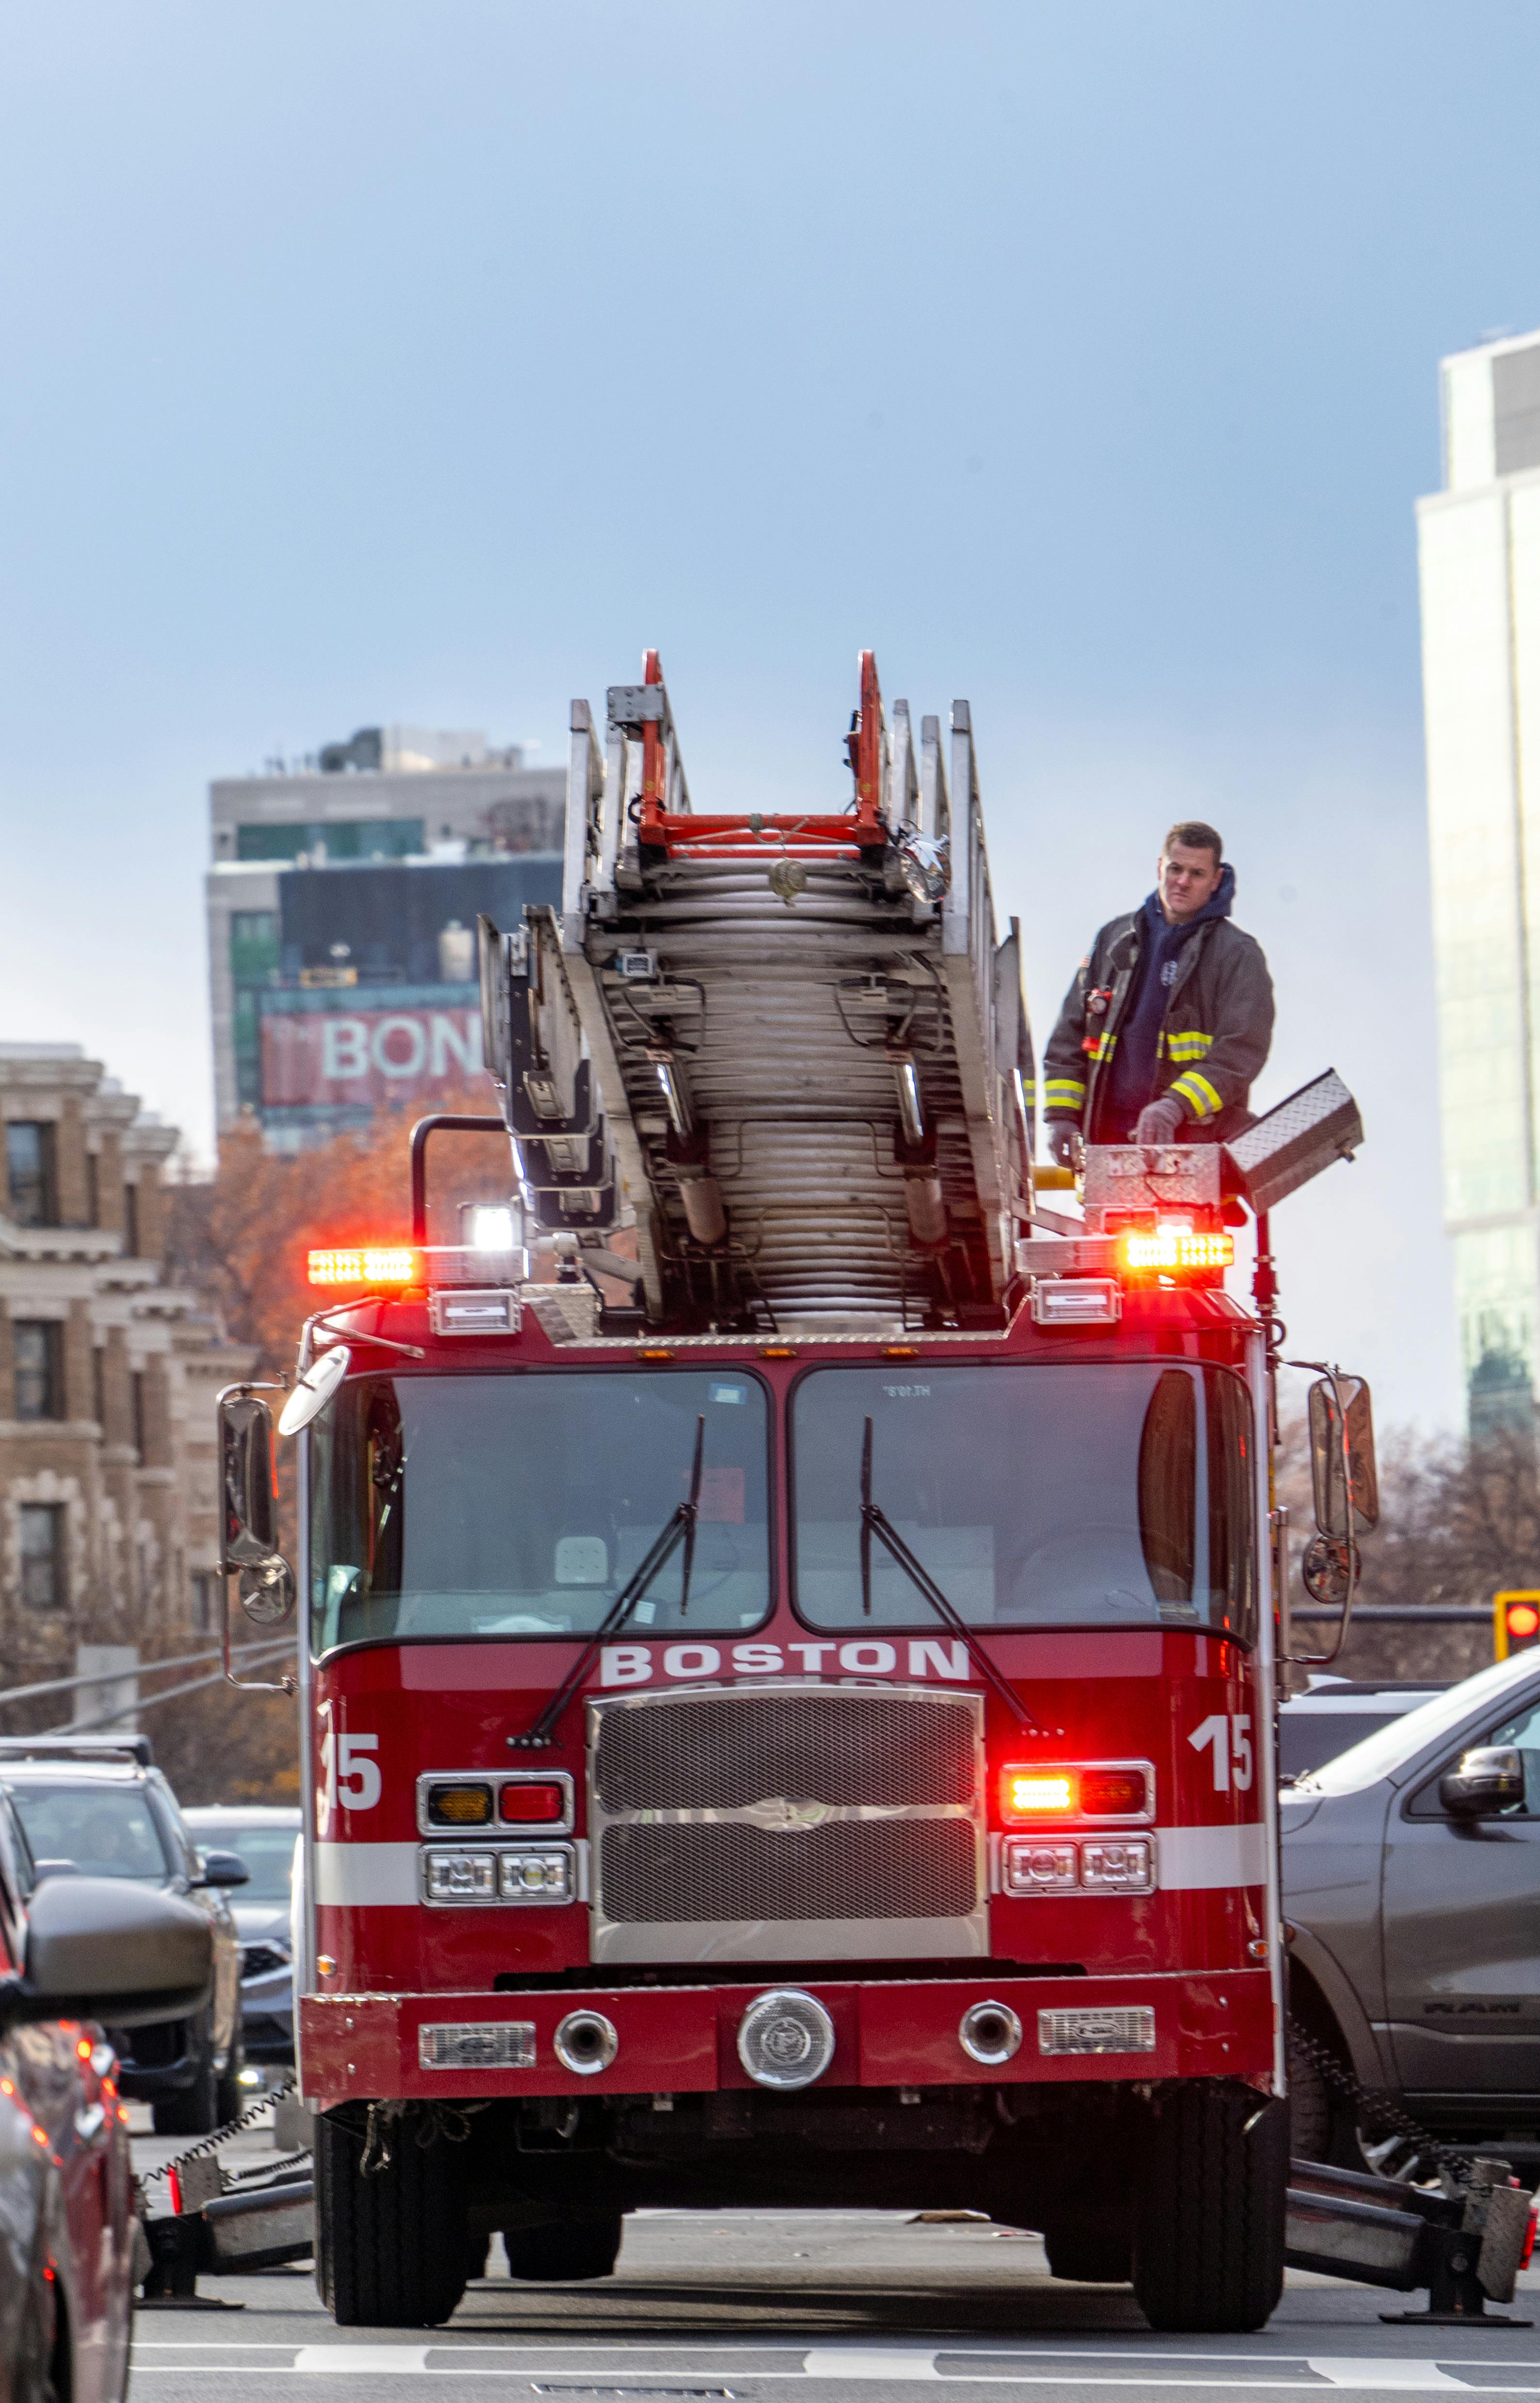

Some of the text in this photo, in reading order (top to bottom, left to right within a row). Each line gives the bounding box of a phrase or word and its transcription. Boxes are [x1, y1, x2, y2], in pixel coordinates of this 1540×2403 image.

[601, 1640, 970, 1687] BOSTON
[320, 1733, 382, 1811] 15
[1187, 1714, 1253, 1791] 15
[1424, 2002, 1520, 2014] RAM
